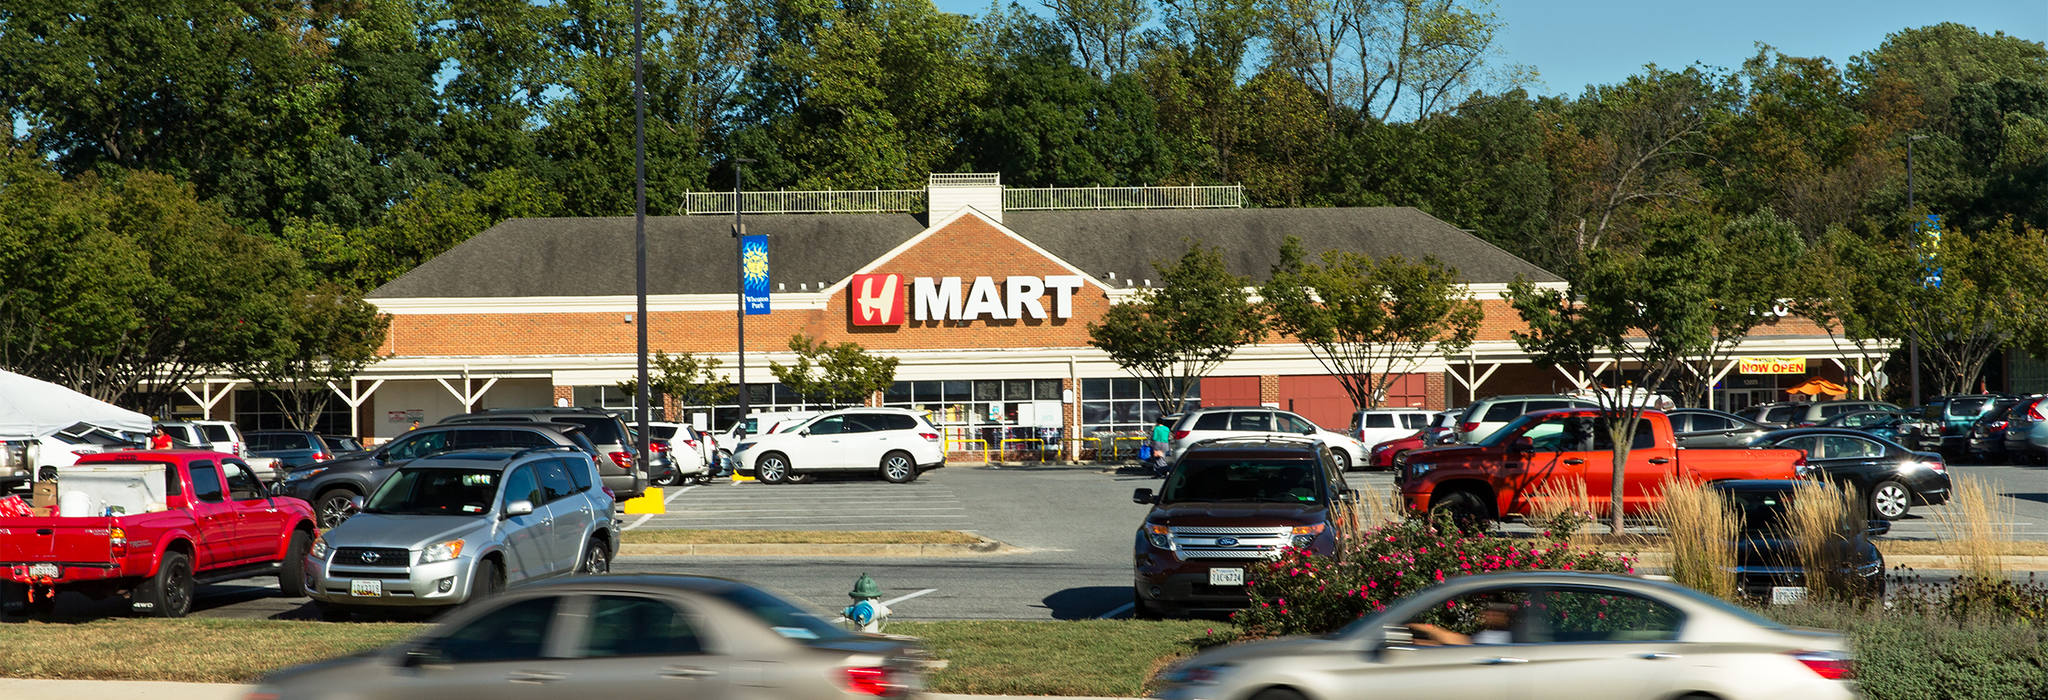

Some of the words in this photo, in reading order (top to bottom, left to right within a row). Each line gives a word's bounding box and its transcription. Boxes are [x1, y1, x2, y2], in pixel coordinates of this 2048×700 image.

[857, 274, 898, 325] H
[913, 275, 1085, 321] MART
[1742, 363, 1768, 373] NOW
[1772, 363, 1804, 373] OPEN
